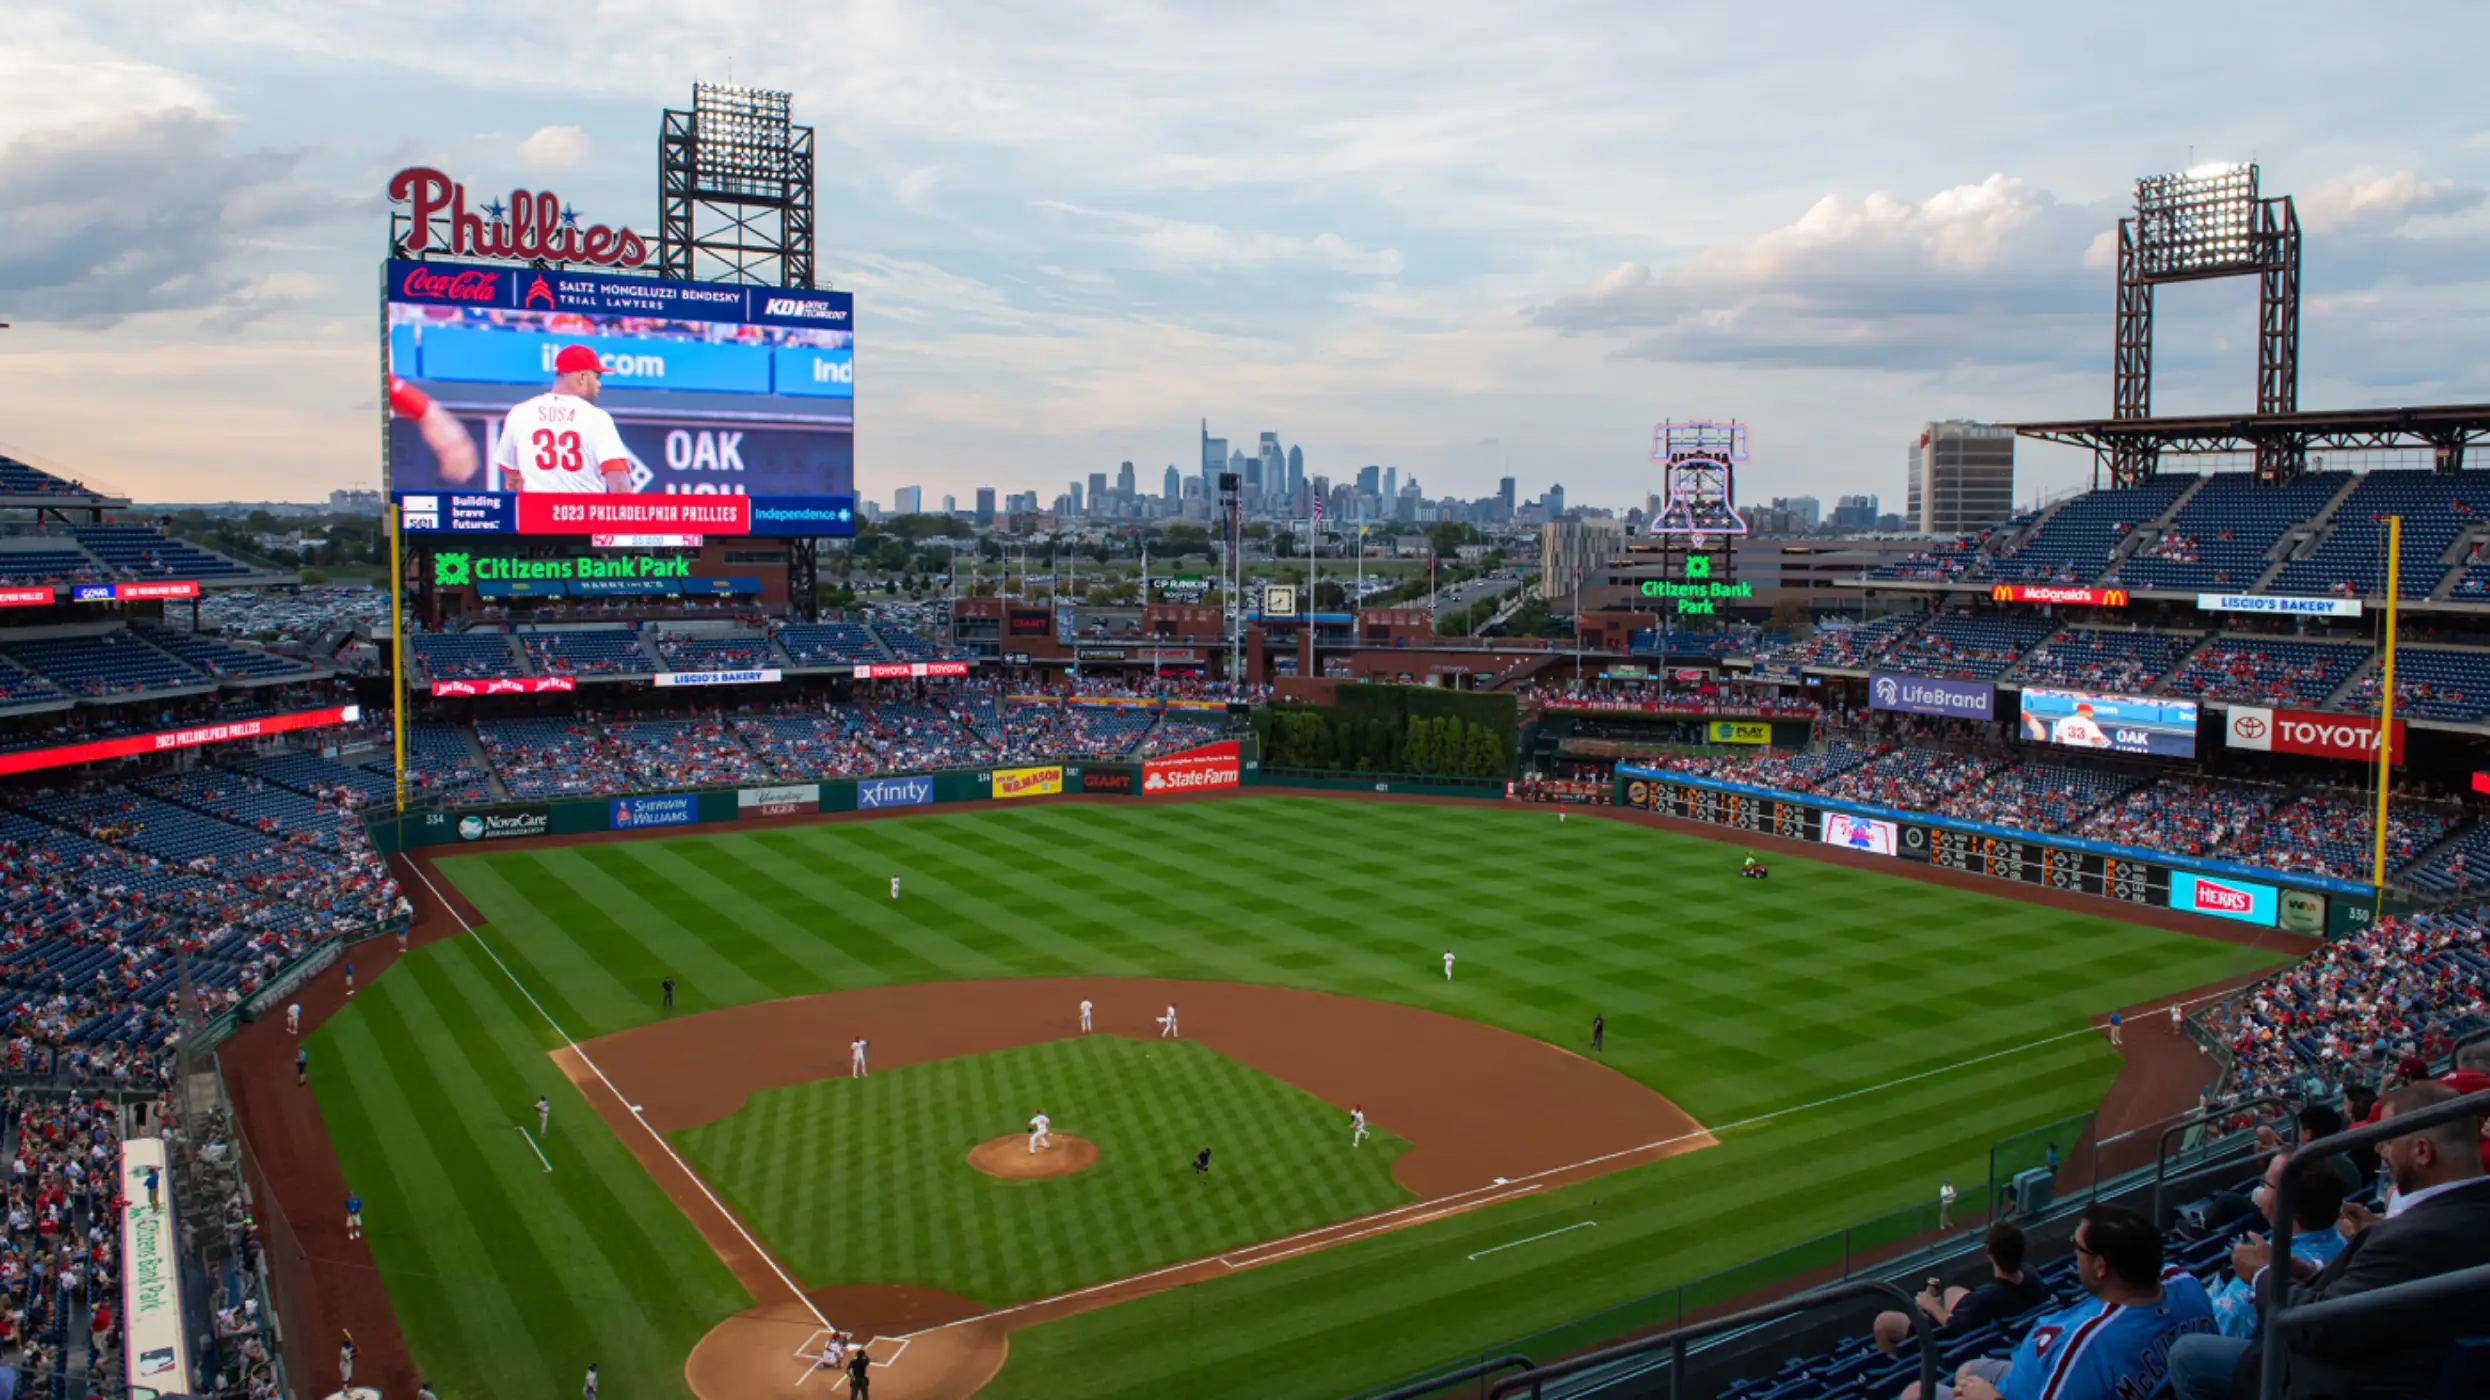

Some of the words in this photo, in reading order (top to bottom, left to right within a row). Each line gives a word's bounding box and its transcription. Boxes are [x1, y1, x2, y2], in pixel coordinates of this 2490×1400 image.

[388, 166, 647, 268] Phillies
[403, 267, 500, 301] Coca-Cola
[559, 280, 595, 294] SALTZ
[601, 285, 677, 300] MONGELUZZI
[681, 289, 740, 304] BENDESKY
[559, 294, 597, 306] TRIAL
[606, 297, 664, 311] LAWYERS
[538, 406, 576, 423] SOSA
[531, 428, 584, 472] 33
[664, 429, 745, 471] OAK
[452, 496, 502, 509] Building
[452, 507, 486, 518] brave
[552, 505, 585, 521] 2023
[589, 505, 678, 521] PHILADELPHIA
[682, 506, 737, 522] PHILLIES
[755, 508, 836, 522] Independence
[474, 557, 572, 579] Citizens
[577, 556, 635, 579] Bank
[640, 555, 690, 577] Park
[1641, 582, 1708, 598] Citizens
[1710, 582, 1752, 598] Bank
[2024, 587, 2091, 602] McDonald's
[1677, 600, 1715, 615] Park
[2221, 595, 2277, 611] LISCIO'S
[2280, 597, 2336, 613] BAKERY
[674, 673, 719, 684] LISCIO'S
[721, 671, 762, 682] BAKERY
[872, 666, 910, 676] TOYOTA
[929, 664, 965, 674] TOYOTA
[1902, 685, 1987, 710] LifeBrand
[2067, 726, 2086, 739] 33
[2116, 729, 2149, 745] OAK
[1083, 775, 1131, 788] GIANT
[862, 780, 929, 807] xfinity
[635, 798, 688, 812] SHERWIN
[2199, 886, 2246, 909] HERR'S
